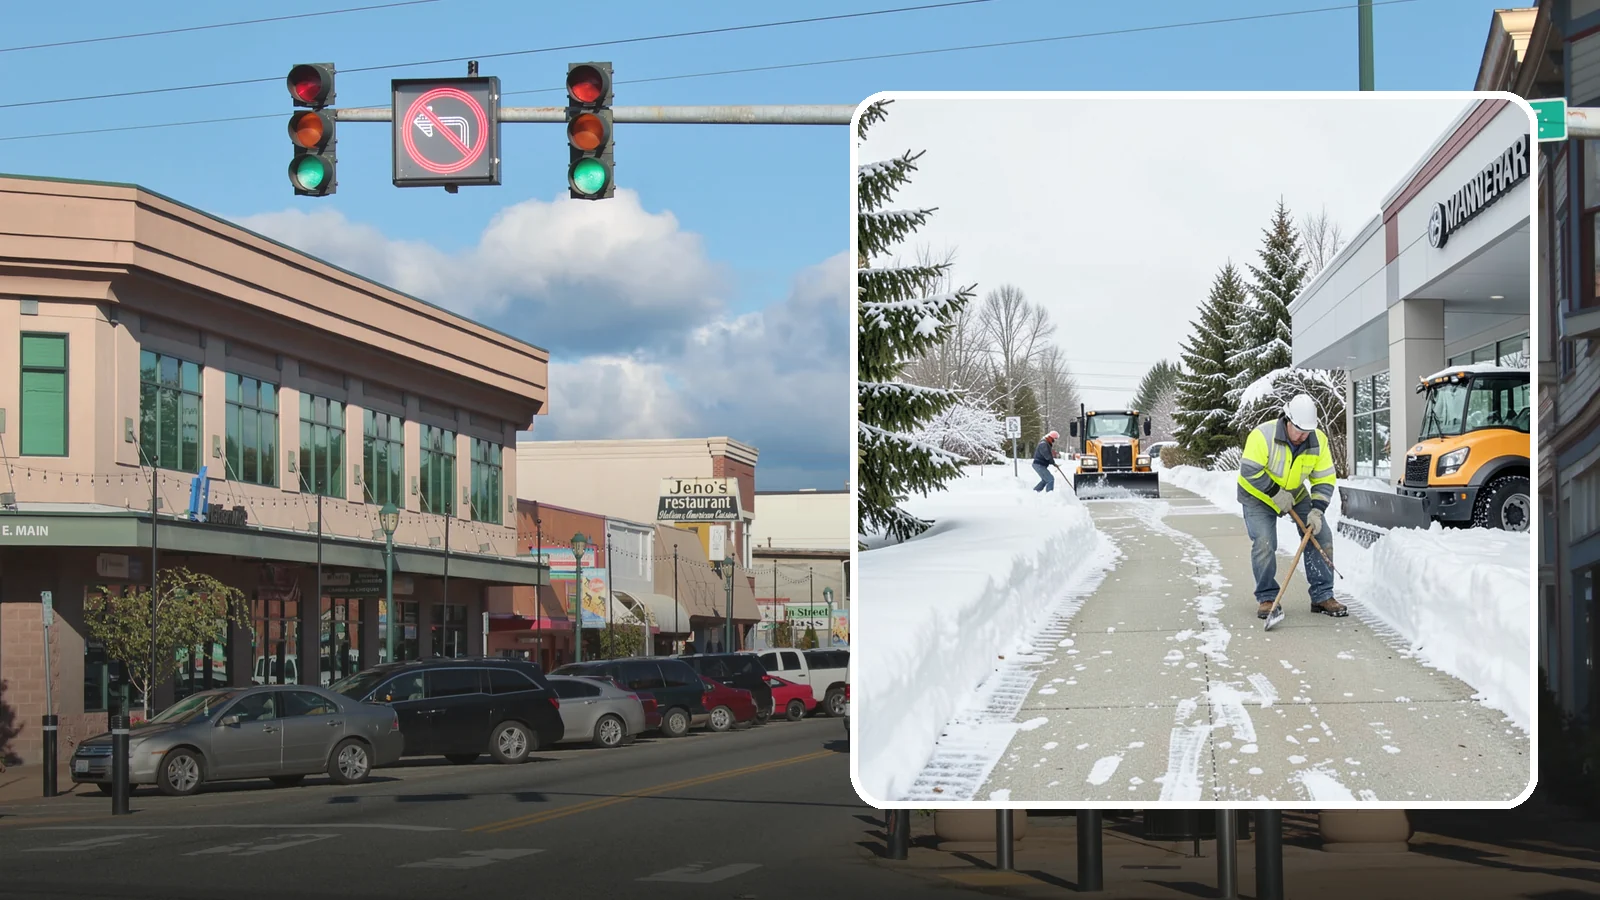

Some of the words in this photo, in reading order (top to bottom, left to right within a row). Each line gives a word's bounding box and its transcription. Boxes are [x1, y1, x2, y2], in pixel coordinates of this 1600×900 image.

[669, 480, 727, 494] Jeno's
[665, 496, 731, 509] restaurant
[686, 510, 715, 519] American
[2, 525, 13, 536] E.
[16, 525, 49, 536] MAIN
[797, 607, 828, 617] Street
